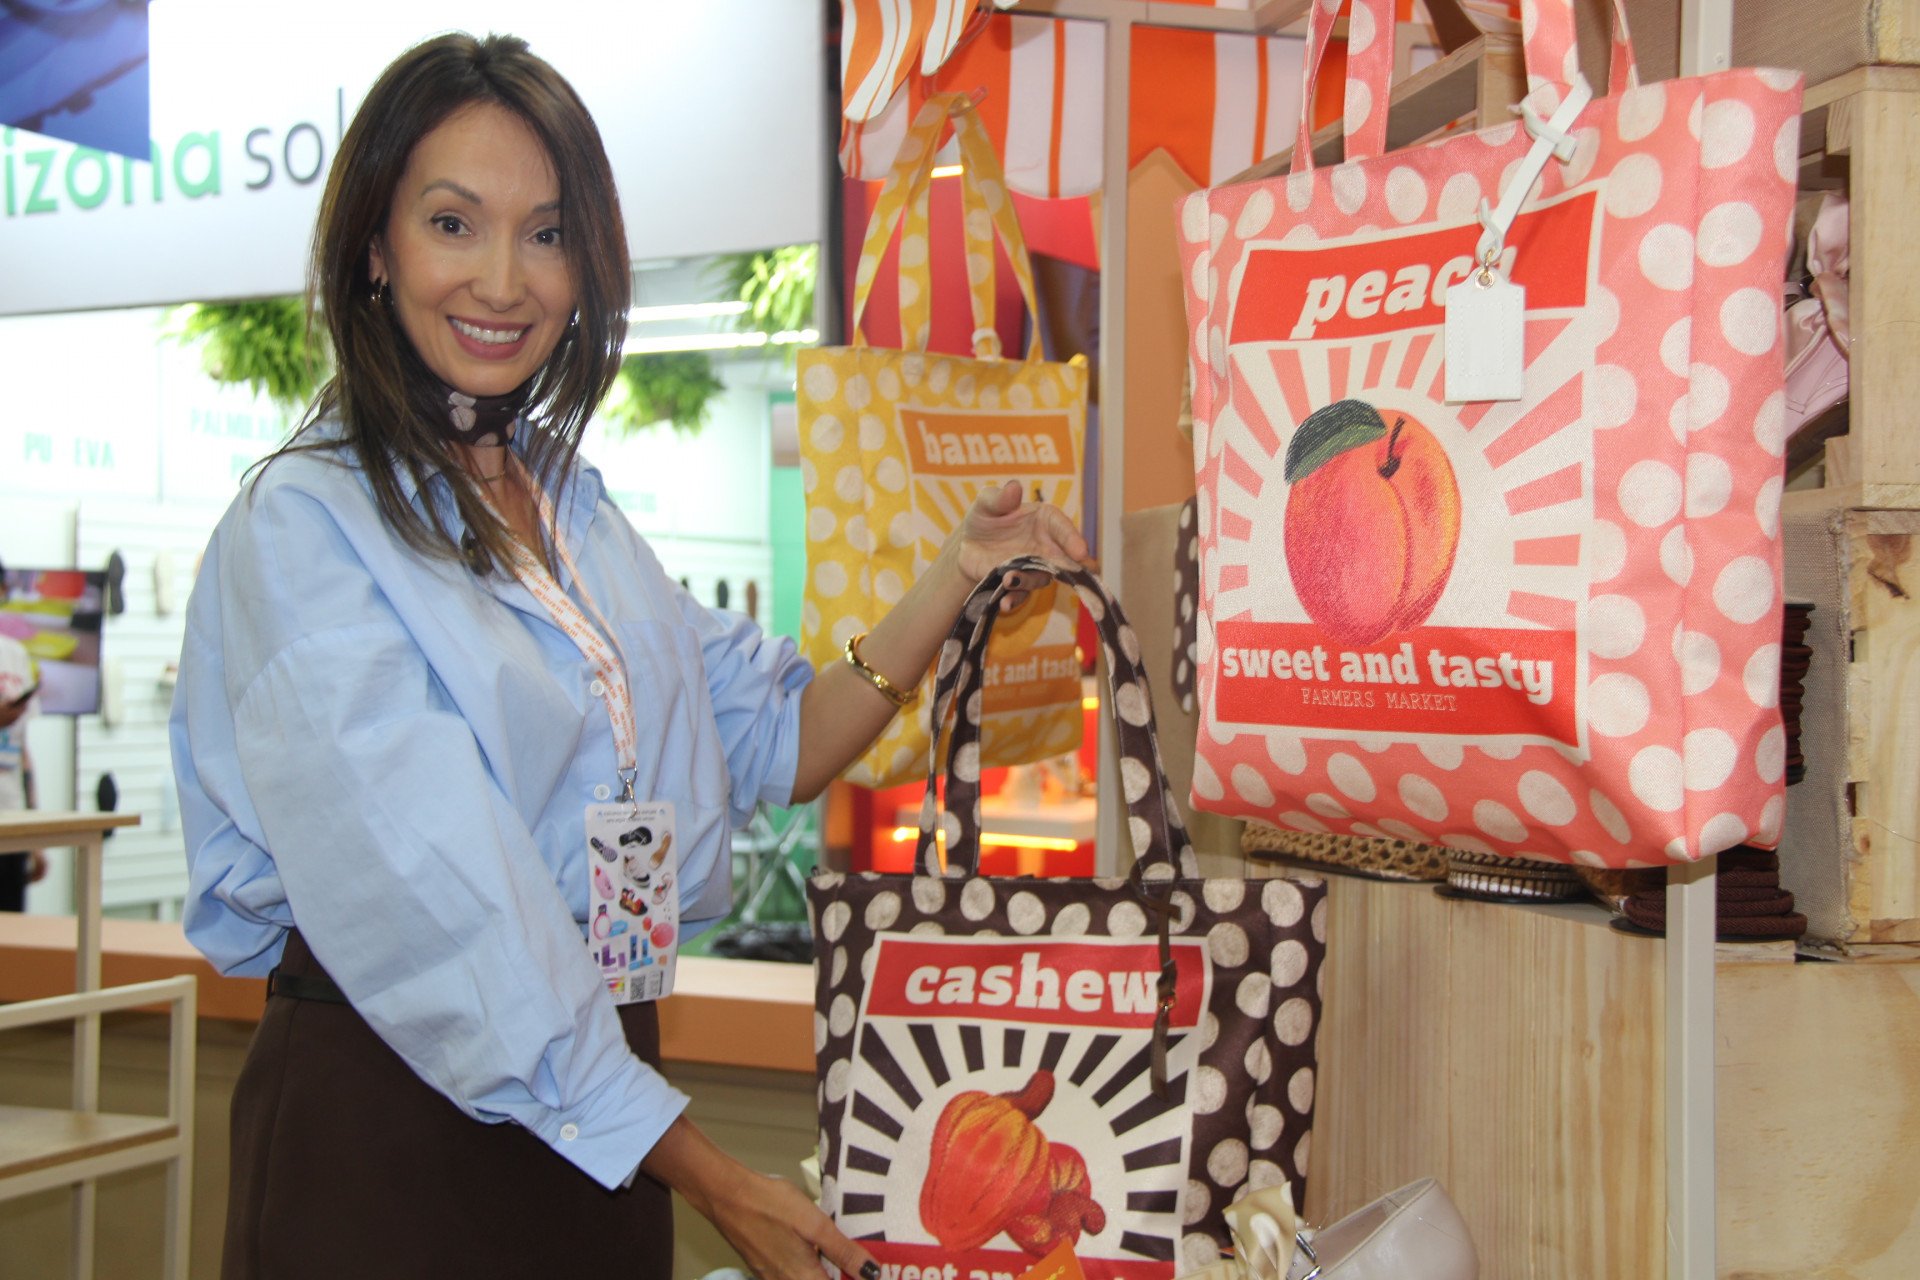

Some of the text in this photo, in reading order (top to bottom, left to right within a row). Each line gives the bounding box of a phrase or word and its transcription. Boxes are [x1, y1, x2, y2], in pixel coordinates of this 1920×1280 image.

[1290, 245, 1518, 340] peac
[916, 420, 1060, 466] banana
[1222, 642, 1555, 706] sweet and tasty
[1301, 688, 1457, 712] FARMERS MARKET
[905, 952, 1164, 1014] cashew
